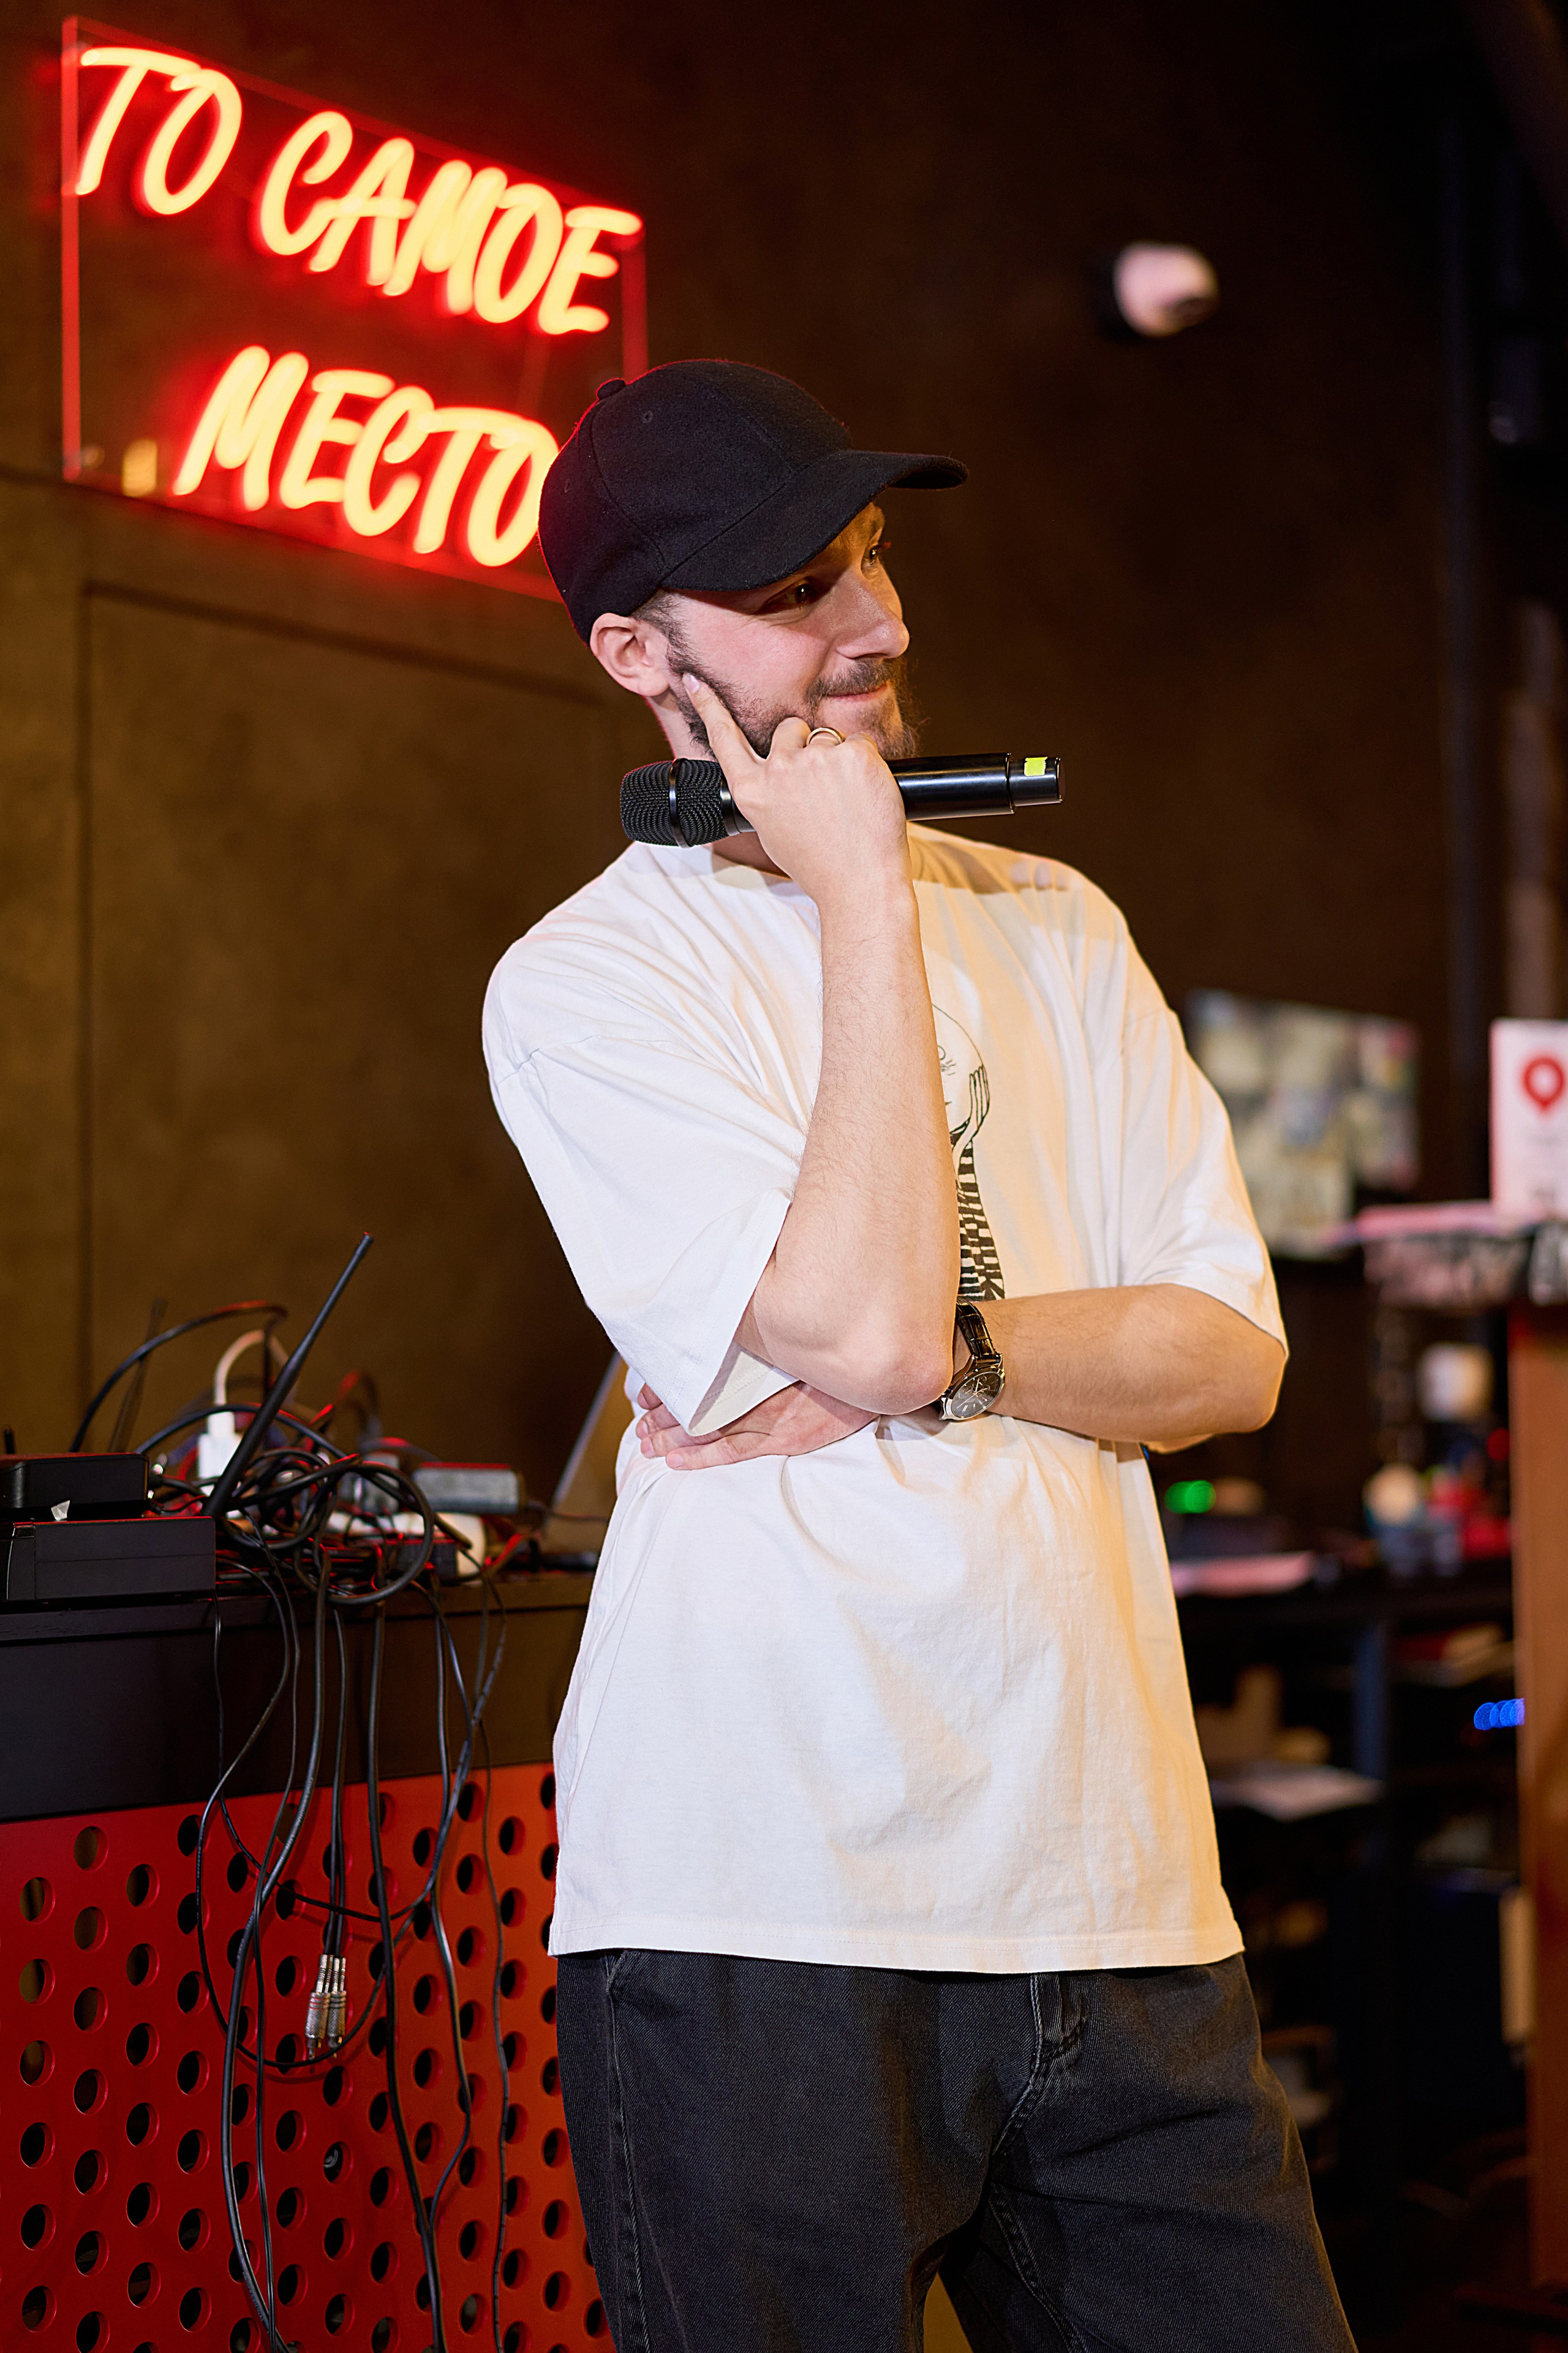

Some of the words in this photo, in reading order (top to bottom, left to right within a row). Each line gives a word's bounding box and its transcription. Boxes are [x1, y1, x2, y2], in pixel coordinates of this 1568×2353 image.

[75, 47, 243, 216] ТО
[260, 111, 641, 335] САМОЕ
[173, 346, 560, 567] МЕСТО
